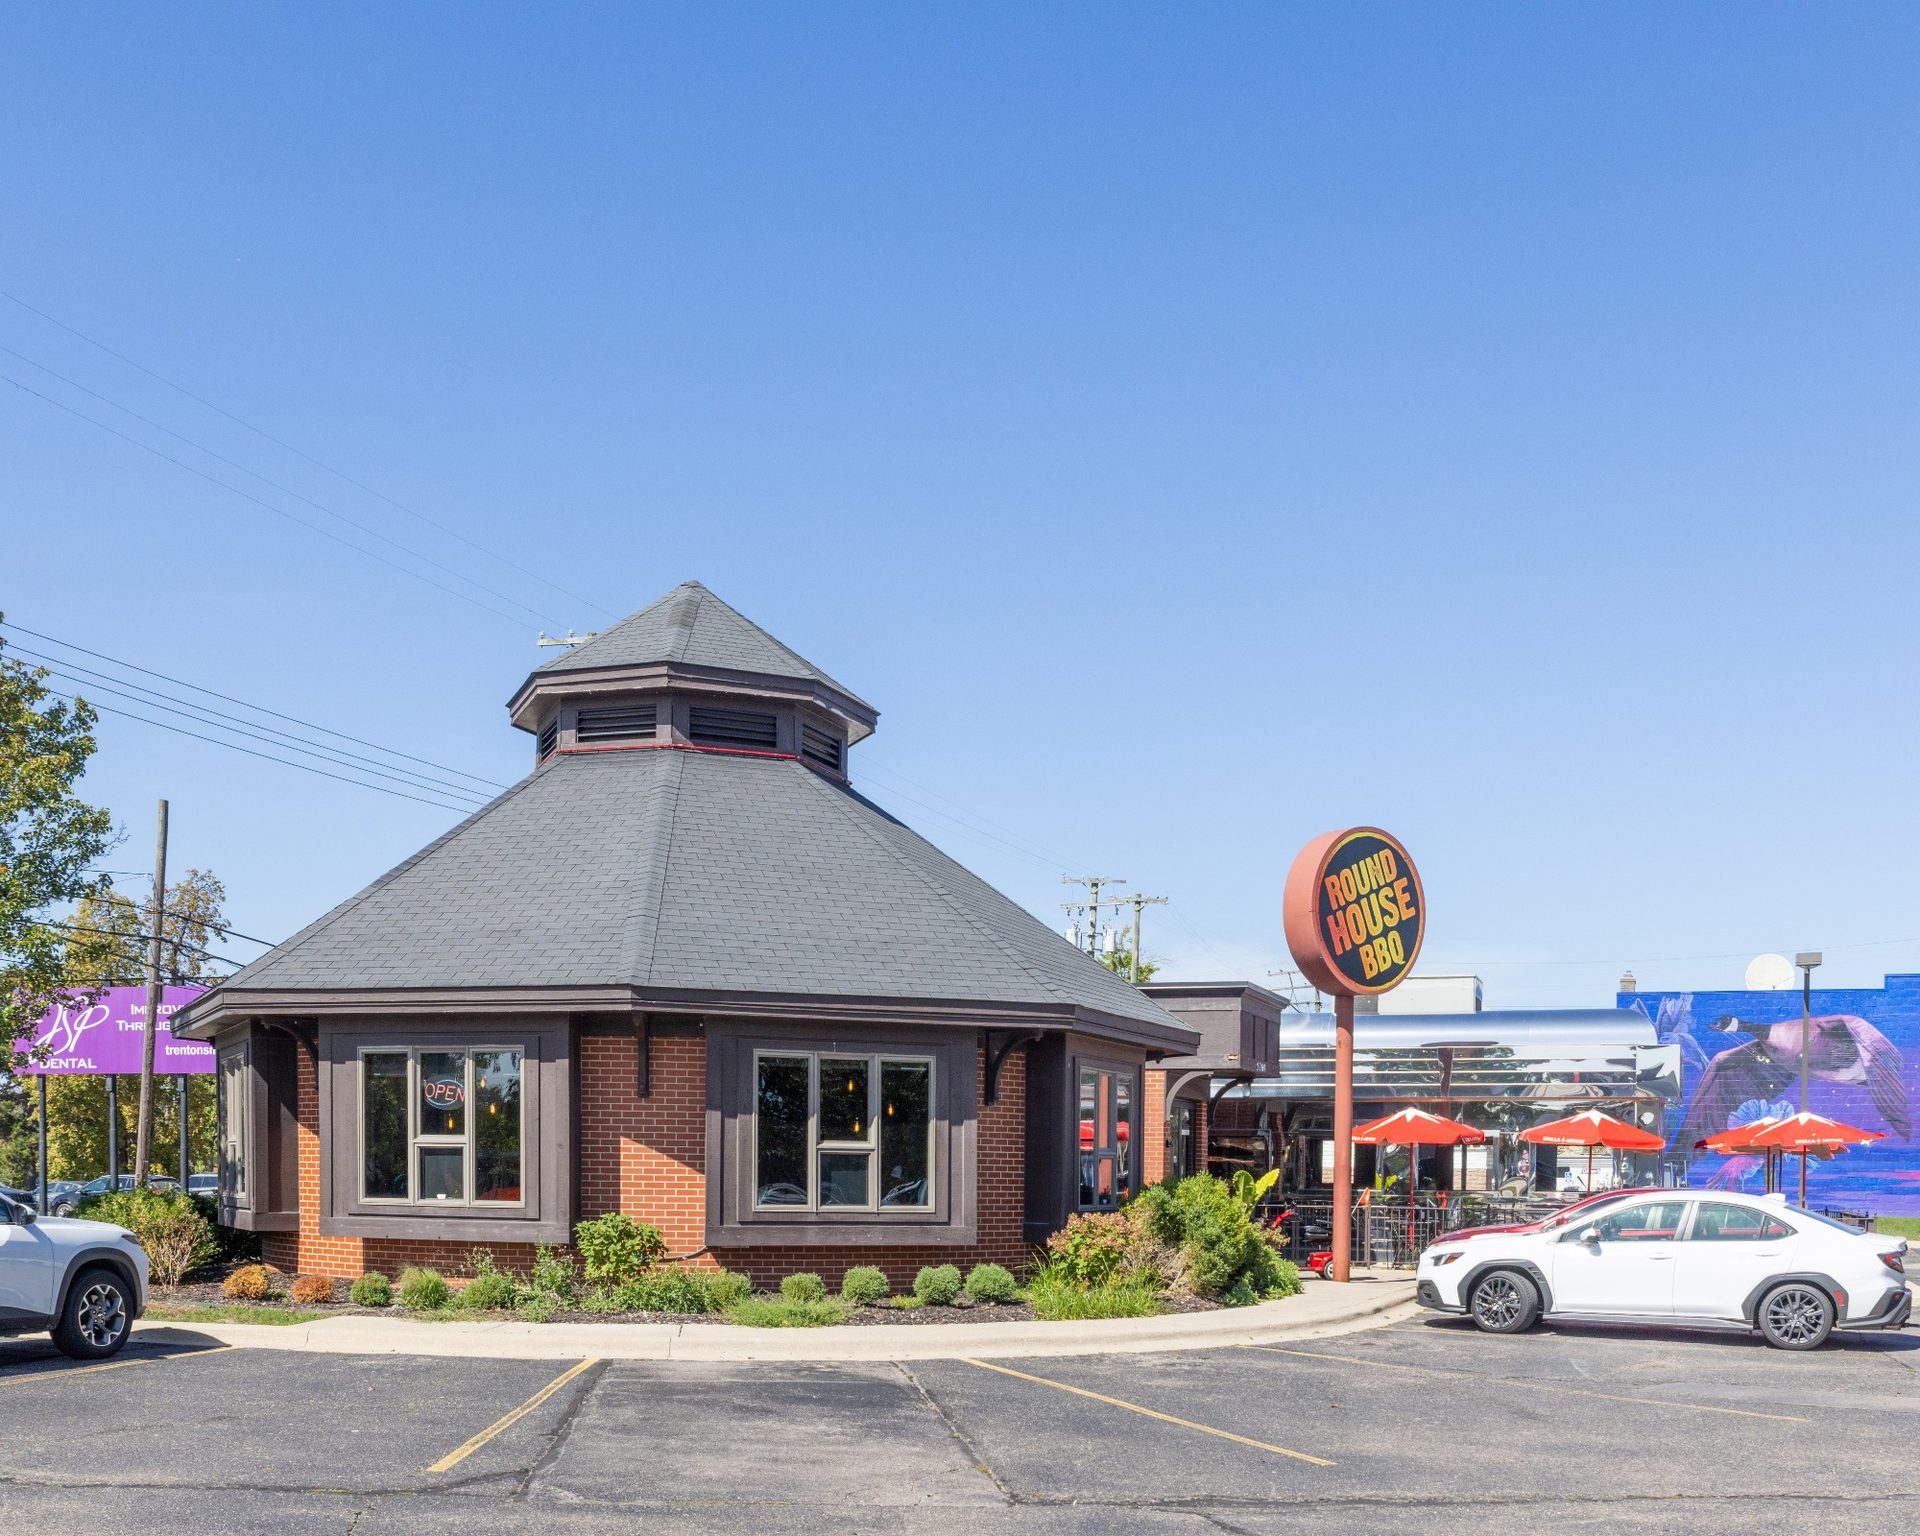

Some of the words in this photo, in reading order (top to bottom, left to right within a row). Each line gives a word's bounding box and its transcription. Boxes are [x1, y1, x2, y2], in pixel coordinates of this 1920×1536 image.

[1325, 848, 1398, 910] ROUND
[1327, 877, 1416, 956] HOUSE
[1359, 930, 1406, 979] BBQ
[130, 1004, 186, 1015] IMROV
[115, 1020, 171, 1032] THRUG
[40, 1057, 98, 1069] DENTAL
[424, 1082, 465, 1102] OPEN
